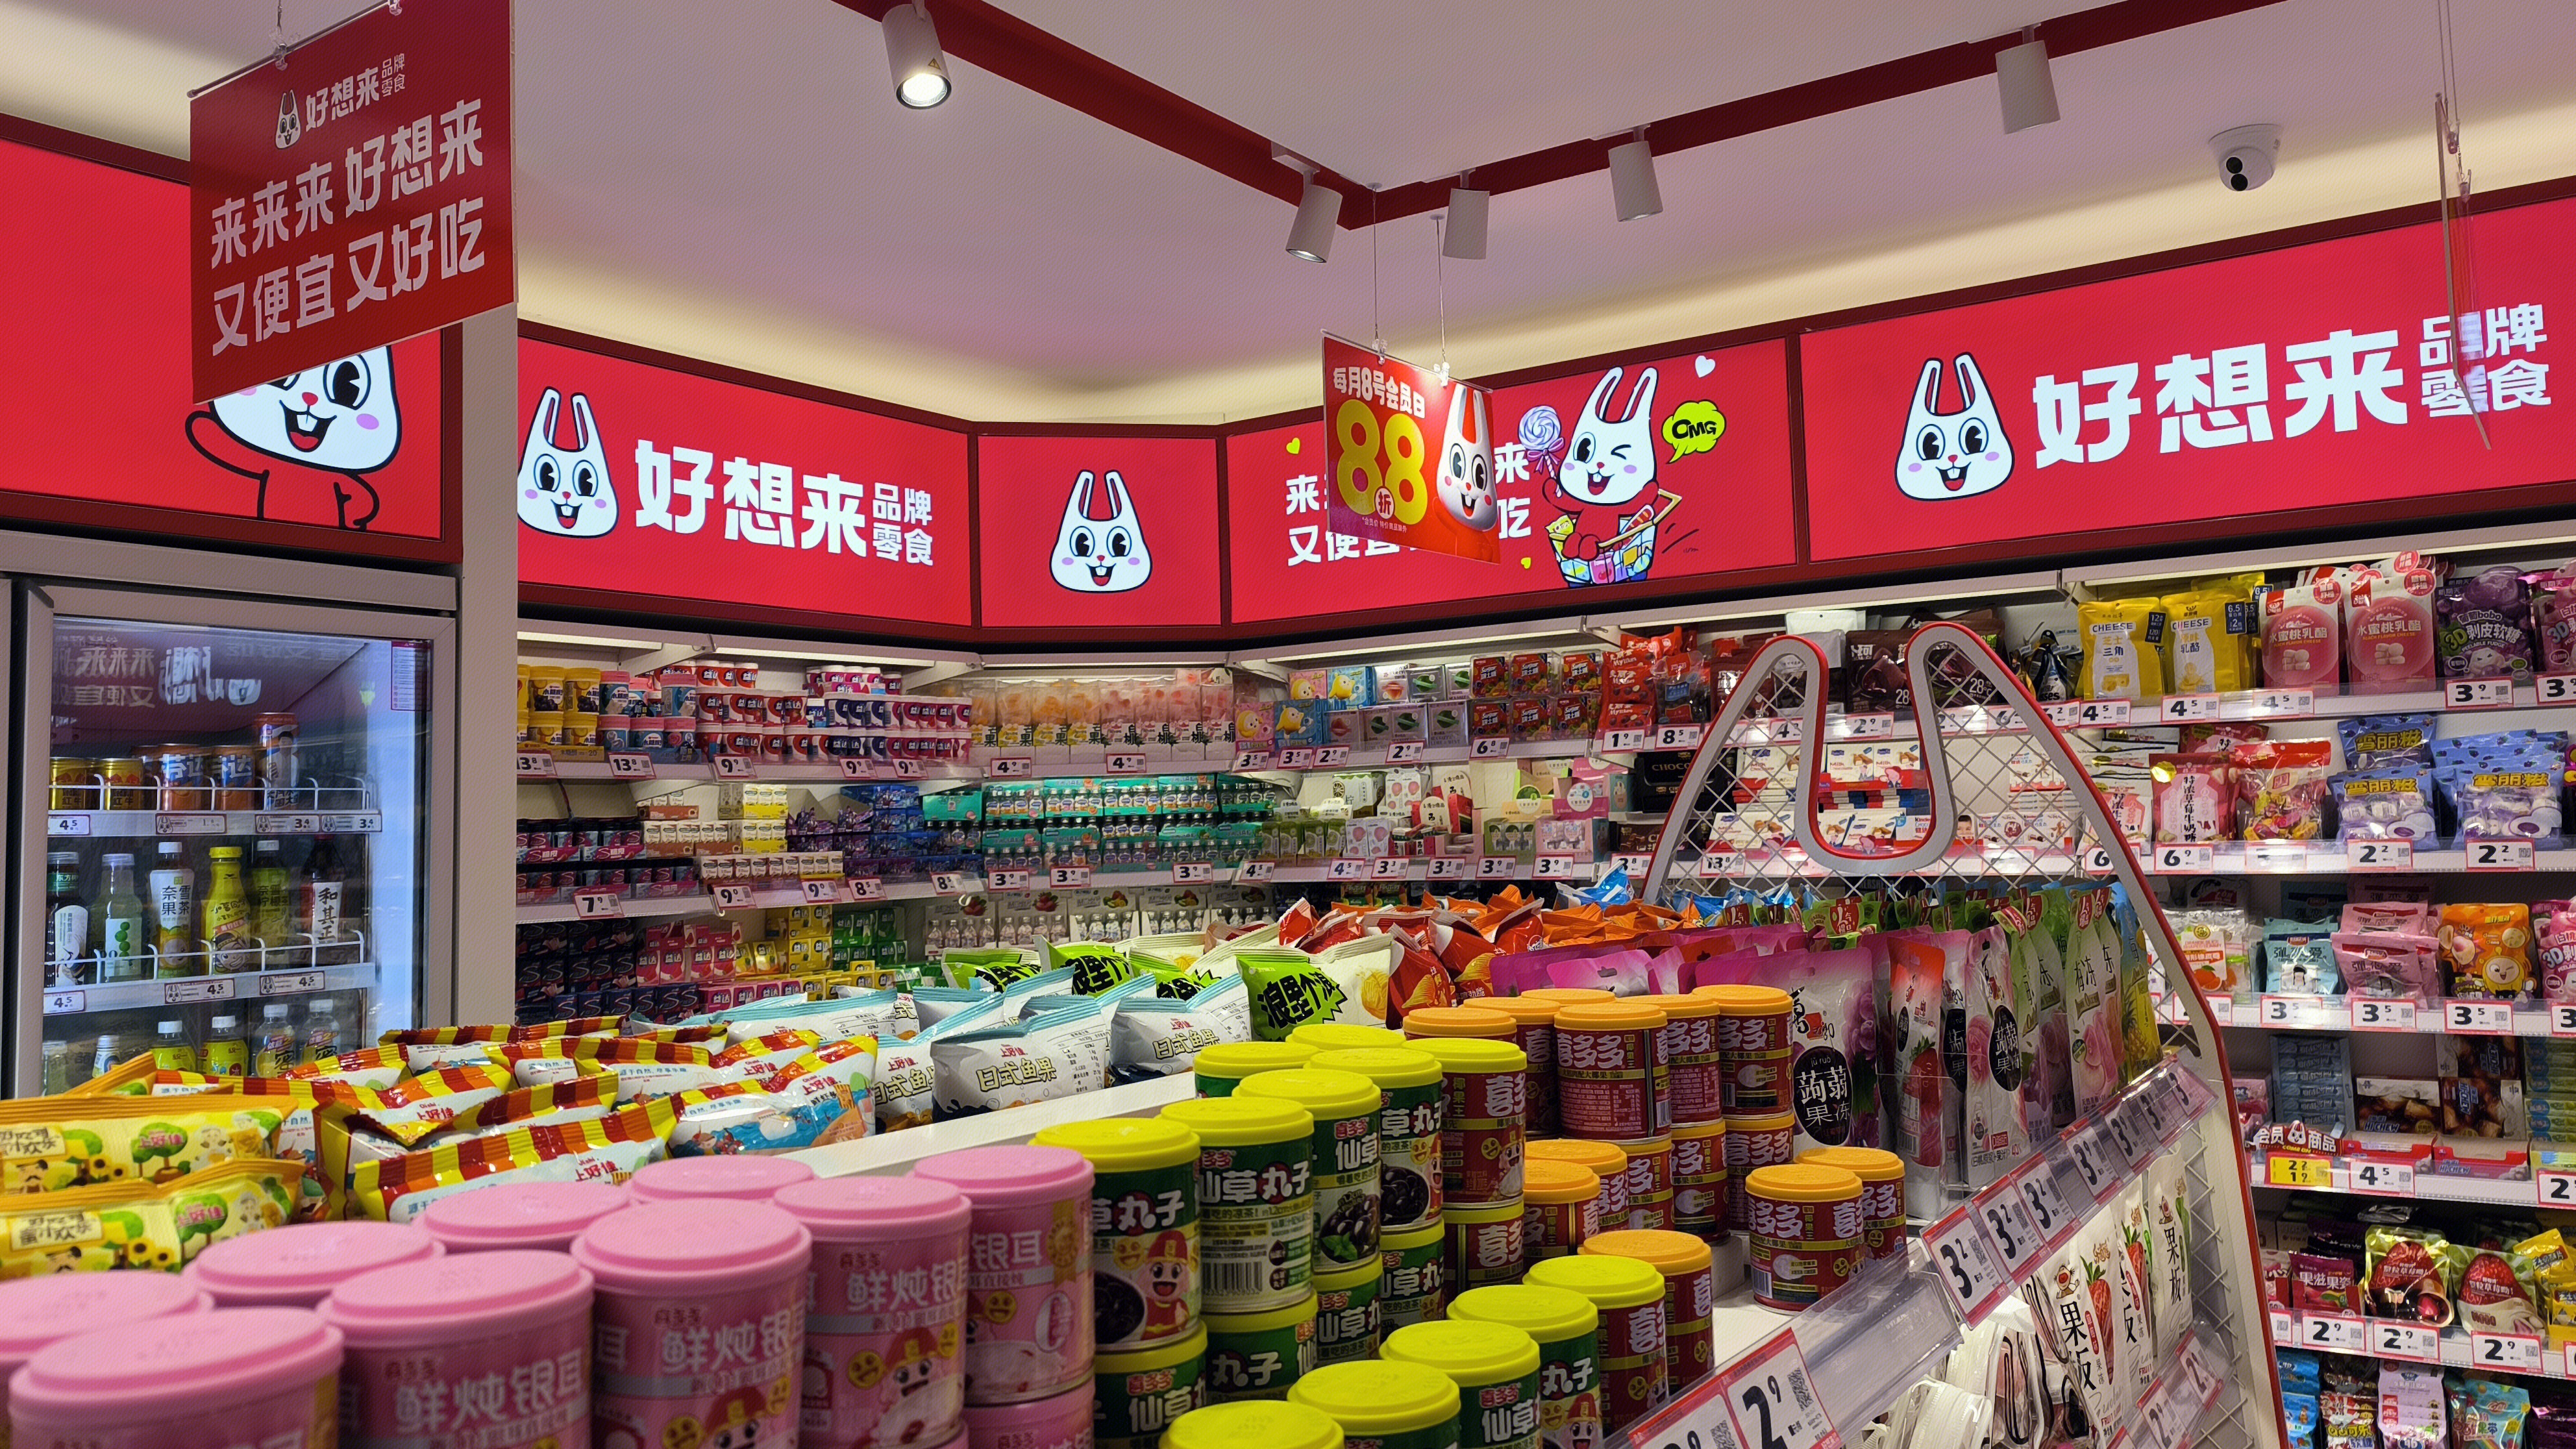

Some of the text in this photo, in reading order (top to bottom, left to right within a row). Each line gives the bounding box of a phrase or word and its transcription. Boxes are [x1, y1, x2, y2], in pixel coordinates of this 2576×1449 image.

[381, 53, 405, 78] 品牌
[381, 73, 405, 97] 零食
[306, 68, 379, 132] 好想来
[212, 98, 482, 269] 来来来 好想来
[212, 197, 484, 356] 又便宜 又好吃
[2420, 303, 2547, 366] 品牌
[1333, 367, 1425, 418] 每月8号会员日
[2032, 328, 2408, 469] 好想来
[2421, 359, 2551, 419] 零食
[1672, 419, 1718, 439] OMG
[1337, 399, 1428, 525] 88
[635, 440, 867, 558] 好想来
[872, 482, 932, 525] 品牌
[1286, 475, 1327, 515] 来
[1378, 491, 1391, 519] 折
[873, 521, 934, 566] 零食
[2092, 623, 2133, 633] CHEESE
[2173, 619, 2209, 629] CHEESE
[2270, 627, 2327, 643] 水蜜桃乳酪
[2357, 620, 2421, 636] 水蜜桃乳酪
[2466, 622, 2522, 643] 剥皮软糖
[2547, 621, 2569, 644] 3D
[2181, 643, 2199, 653] 乳酪
[2446, 628, 2467, 649] 3D
[2103, 646, 2124, 656] 三角
[2357, 729, 2424, 752] 雪丽糍
[2344, 777, 2419, 796] 雪丽糍
[2473, 773, 2551, 788] 雪丽糍
[162, 885, 191, 900] 奈雪
[162, 901, 190, 916] 果茶
[318, 887, 338, 941] 和其正
[2542, 947, 2564, 969] 3D
[1152, 1028, 1220, 1060] 日式鱼果
[1557, 1033, 1626, 1069] 喜多多
[743, 1062, 777, 1076] 上好佳
[888, 1057, 916, 1072] 上好佳
[976, 1056, 1058, 1093] 日式鱼果
[802, 1076, 839, 1095] 上好佳
[1795, 1060, 1850, 1102] 蒟蒻
[1805, 1100, 1850, 1126] 果冻
[139, 1132, 184, 1149] 上好佳
[2308, 1130, 2336, 1153] 商品
[575, 1160, 623, 1182] 上好佳
[178, 1205, 223, 1227] 上好佳
[2164, 1228, 2183, 1302] 果板
[1213, 1351, 1282, 1387] 丸子
[1542, 1357, 1594, 1398] 丸子
